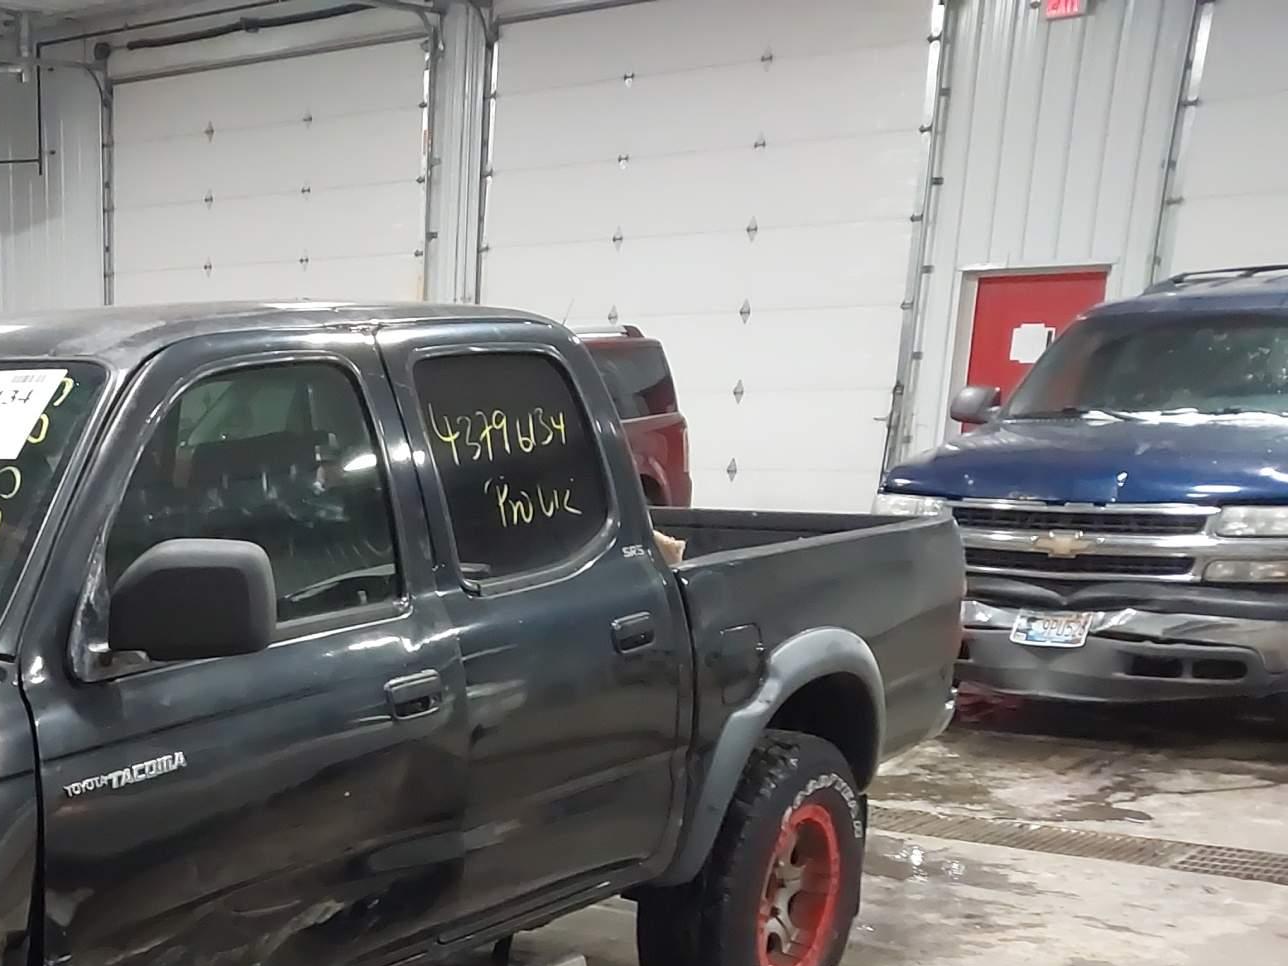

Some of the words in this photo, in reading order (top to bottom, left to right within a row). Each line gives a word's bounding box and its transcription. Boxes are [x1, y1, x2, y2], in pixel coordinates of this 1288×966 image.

[428, 402, 566, 465] 43796134
[63, 775, 109, 798] TOYOTA
[108, 751, 188, 789] TACOMA
